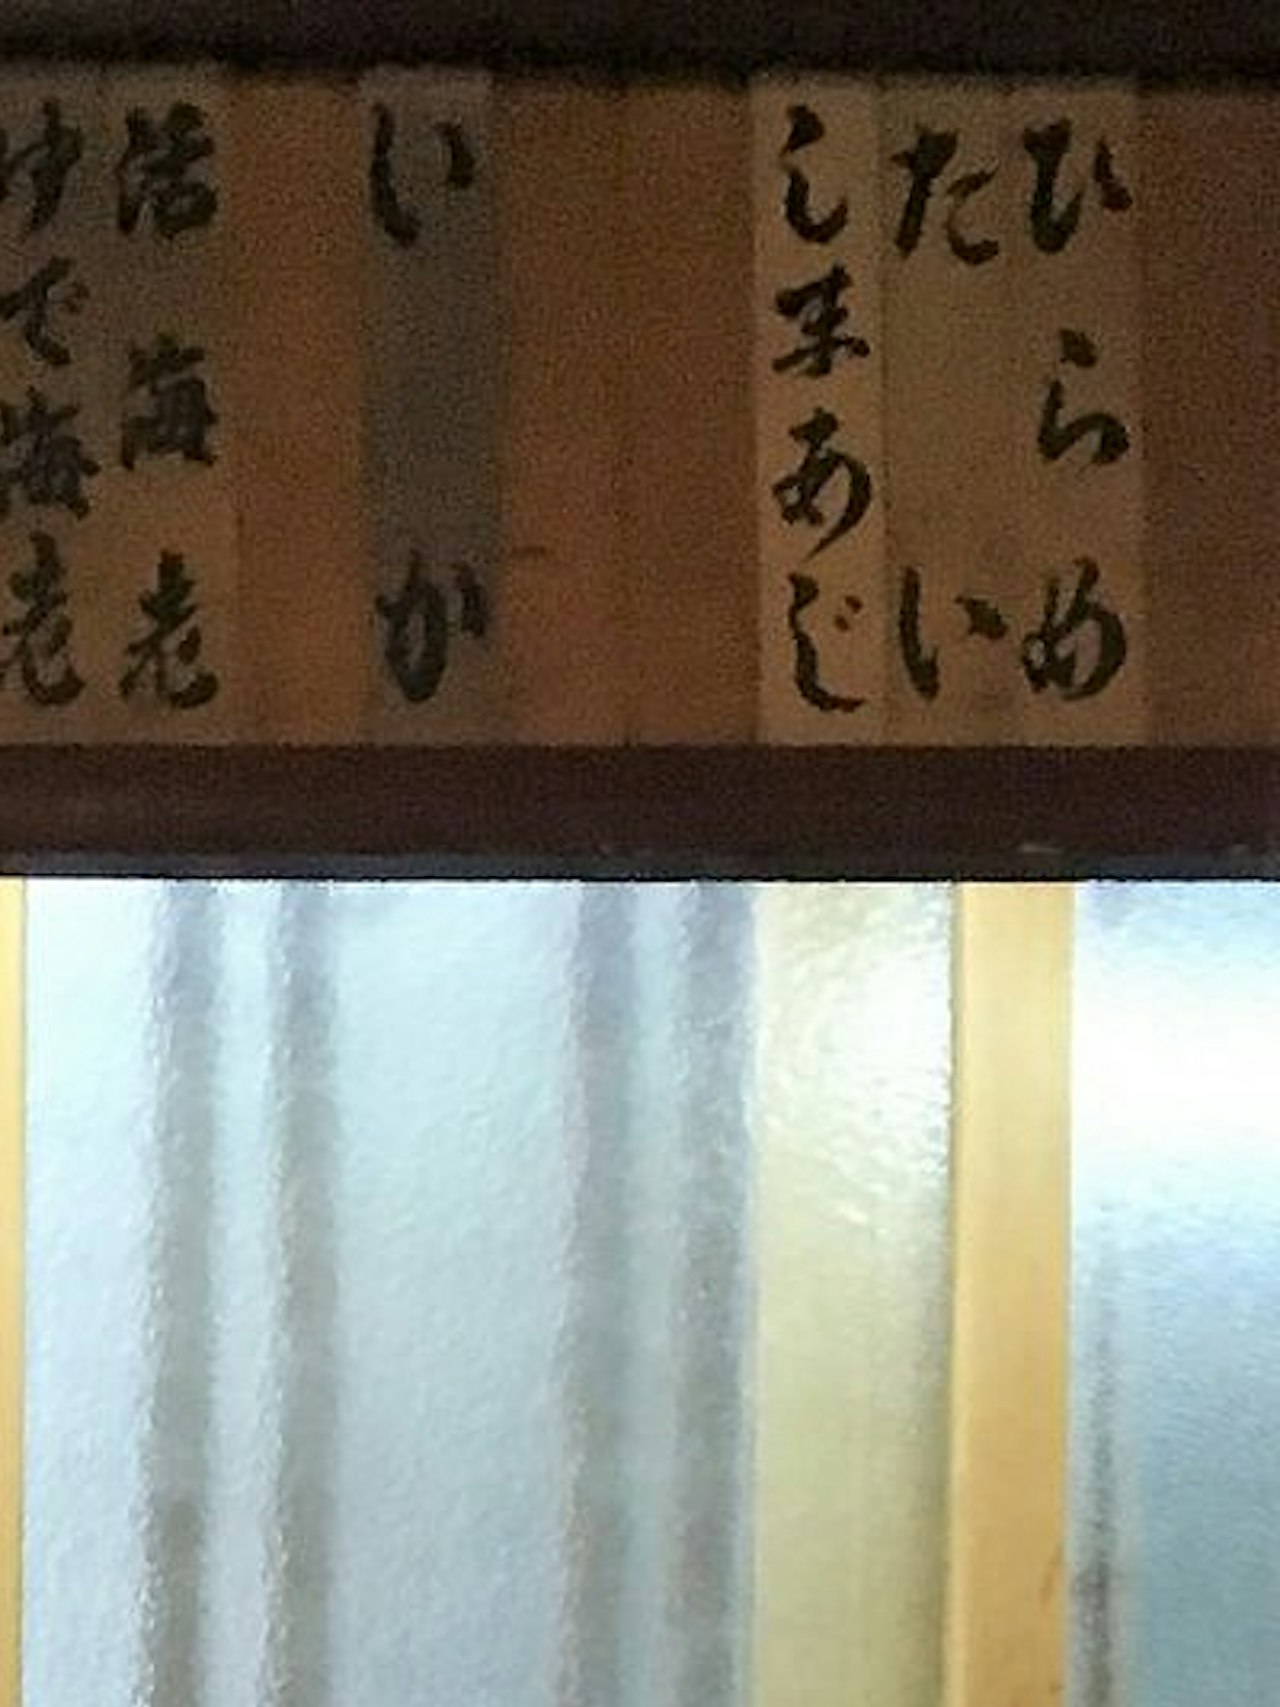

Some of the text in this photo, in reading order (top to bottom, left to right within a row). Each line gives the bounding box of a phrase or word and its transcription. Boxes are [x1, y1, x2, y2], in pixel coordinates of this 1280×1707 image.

[370, 103, 486, 704] いか
[770, 105, 870, 712] しまあじ
[892, 124, 1008, 702] たい
[1020, 116, 1133, 702] ひらめ
